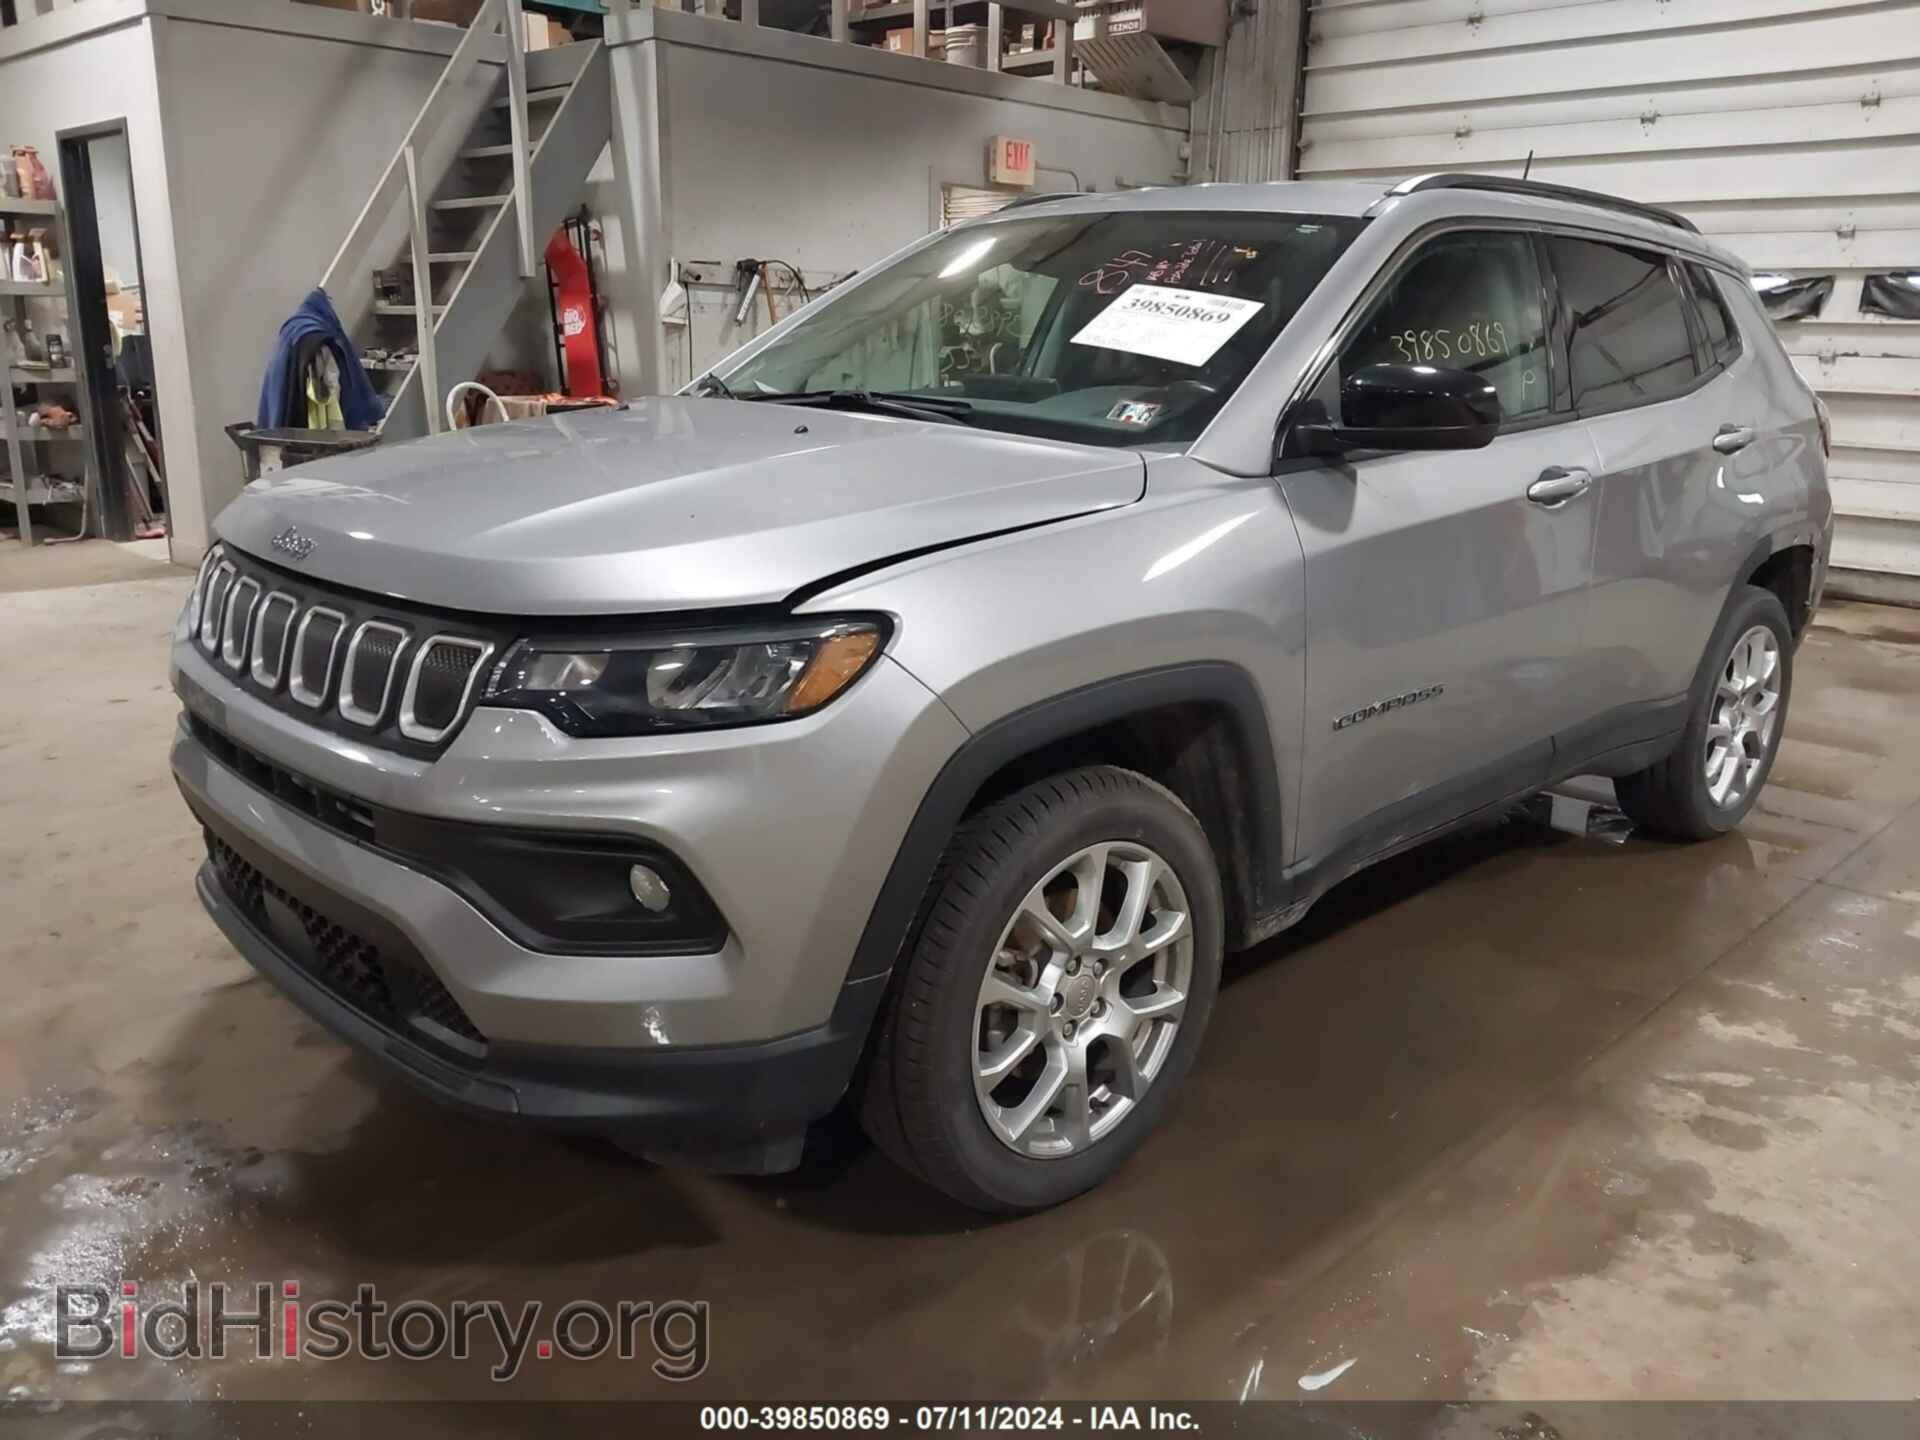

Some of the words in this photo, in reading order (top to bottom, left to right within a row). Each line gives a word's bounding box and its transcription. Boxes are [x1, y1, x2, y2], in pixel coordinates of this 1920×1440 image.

[1005, 141, 1031, 171] EXIT
[1121, 298, 1231, 324] 39850869
[1333, 683, 1444, 731] COMPASS
